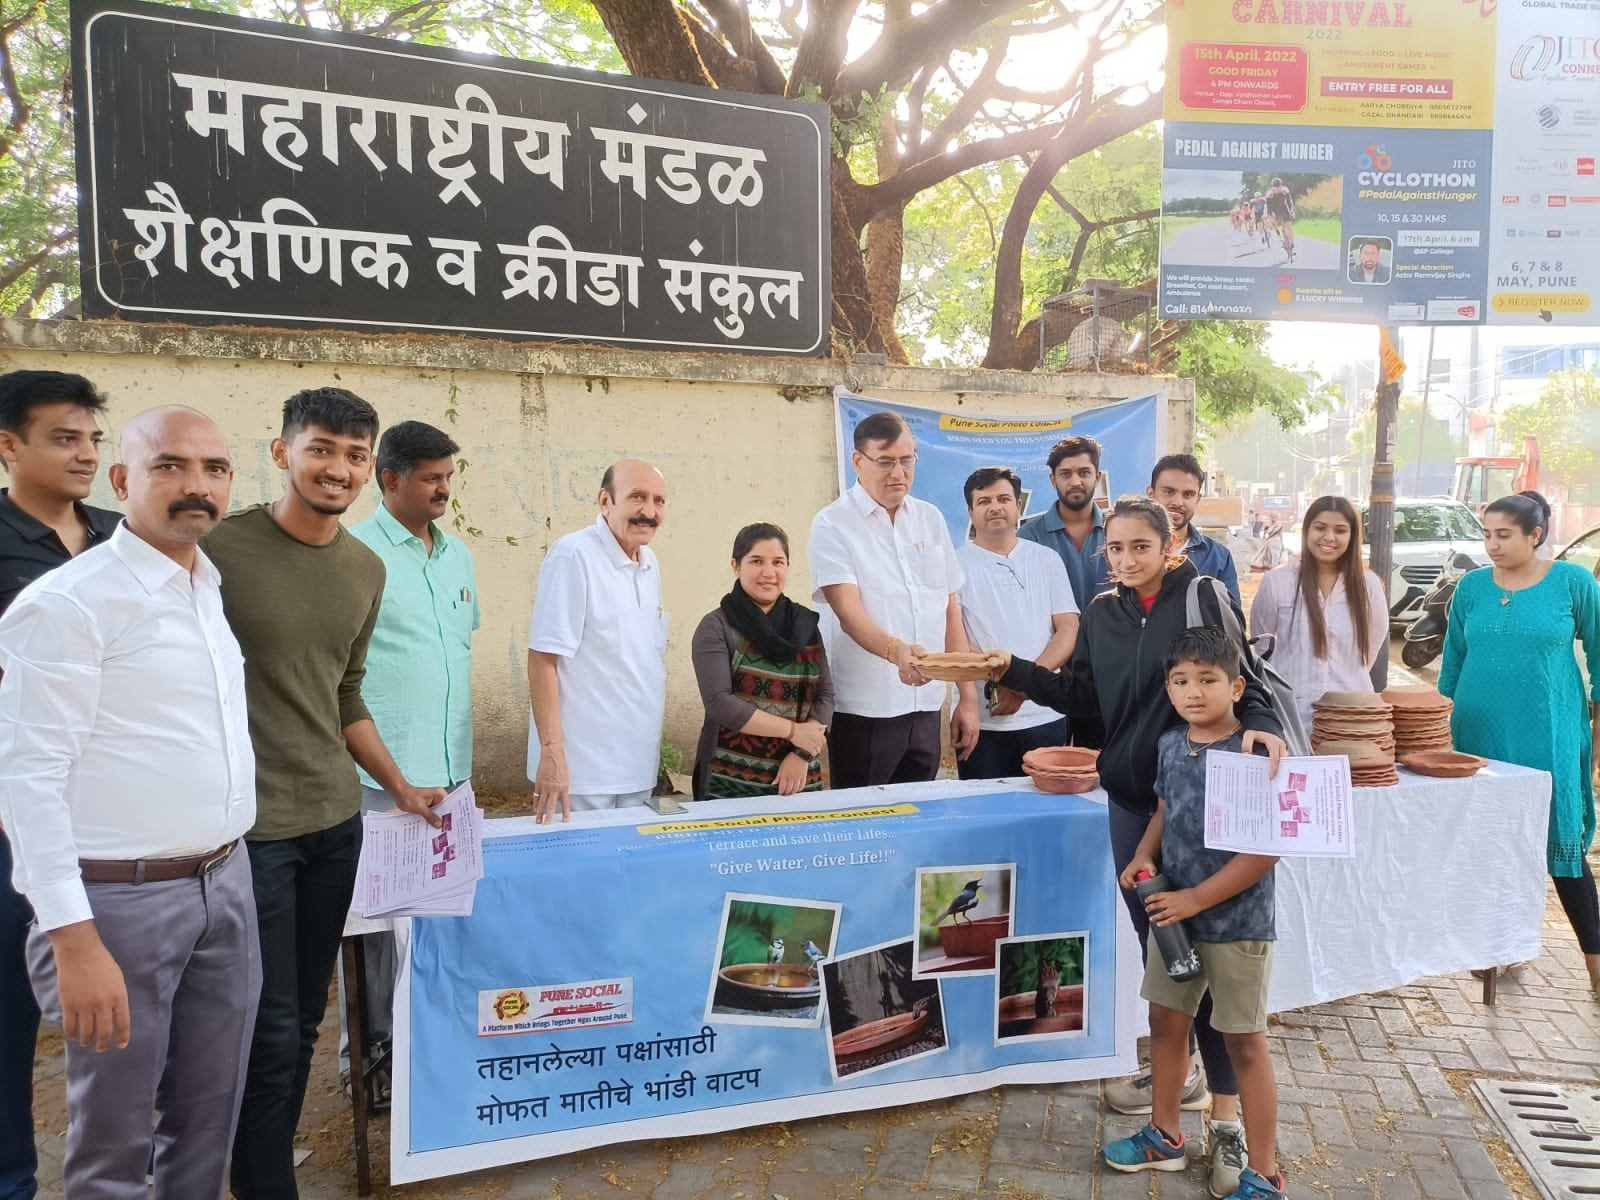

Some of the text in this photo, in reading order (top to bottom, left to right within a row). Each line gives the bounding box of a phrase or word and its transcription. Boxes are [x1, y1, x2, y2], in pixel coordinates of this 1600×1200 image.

[1231, 0, 1413, 28] CARNIVAL
[1305, 28, 1344, 41] 2022
[1195, 47, 1298, 63] 15th April, 2022
[1208, 66, 1280, 77] GOOD FRIDAY
[1217, 80, 1232, 88] PM
[1232, 80, 1280, 90] ONWARDS
[1327, 81, 1449, 95] ENTRY FREE FOR ALL
[171, 72, 768, 208] महाराष्ट्रीय मंडळ
[1174, 138, 1335, 161] PEDAL AGAINST HUNGER
[1451, 159, 1477, 169] JITO
[1357, 171, 1477, 188] CYCLOTHON
[1357, 189, 1478, 202] #PedalAgainstHunger
[1391, 213, 1401, 223] 15
[1409, 213, 1423, 223] 30
[1424, 213, 1448, 224] KMS
[121, 181, 805, 340] शैक्षणिक व क्रीडा संकुल
[1511, 261, 1564, 274] 6, 7 & 8
[1166, 273, 1178, 281] We
[1496, 276, 1577, 288] MAY, PUNE
[1164, 303, 1189, 314] Call:
[950, 417, 975, 428] Pune
[661, 823, 709, 832] Pune
[713, 817, 768, 827] Social
[772, 814, 826, 824] Photo
[829, 808, 897, 819] Contest
[707, 838, 759, 851] Terrace
[762, 833, 788, 847] and
[791, 834, 820, 846] save
[822, 831, 856, 843] their
[709, 848, 897, 876] "Give Water, Give Life!!"
[538, 983, 623, 1003] PUNE SOCIAL
[487, 1023, 514, 1033] Platform
[514, 1022, 531, 1031] Which
[532, 1020, 550, 1031] Brings
[592, 1014, 613, 1023] Around
[476, 1025, 718, 1081] तहानलेल्या पक्षांसाठी
[476, 1067, 762, 1126] मोफत मातीचे भांडी वाटप
